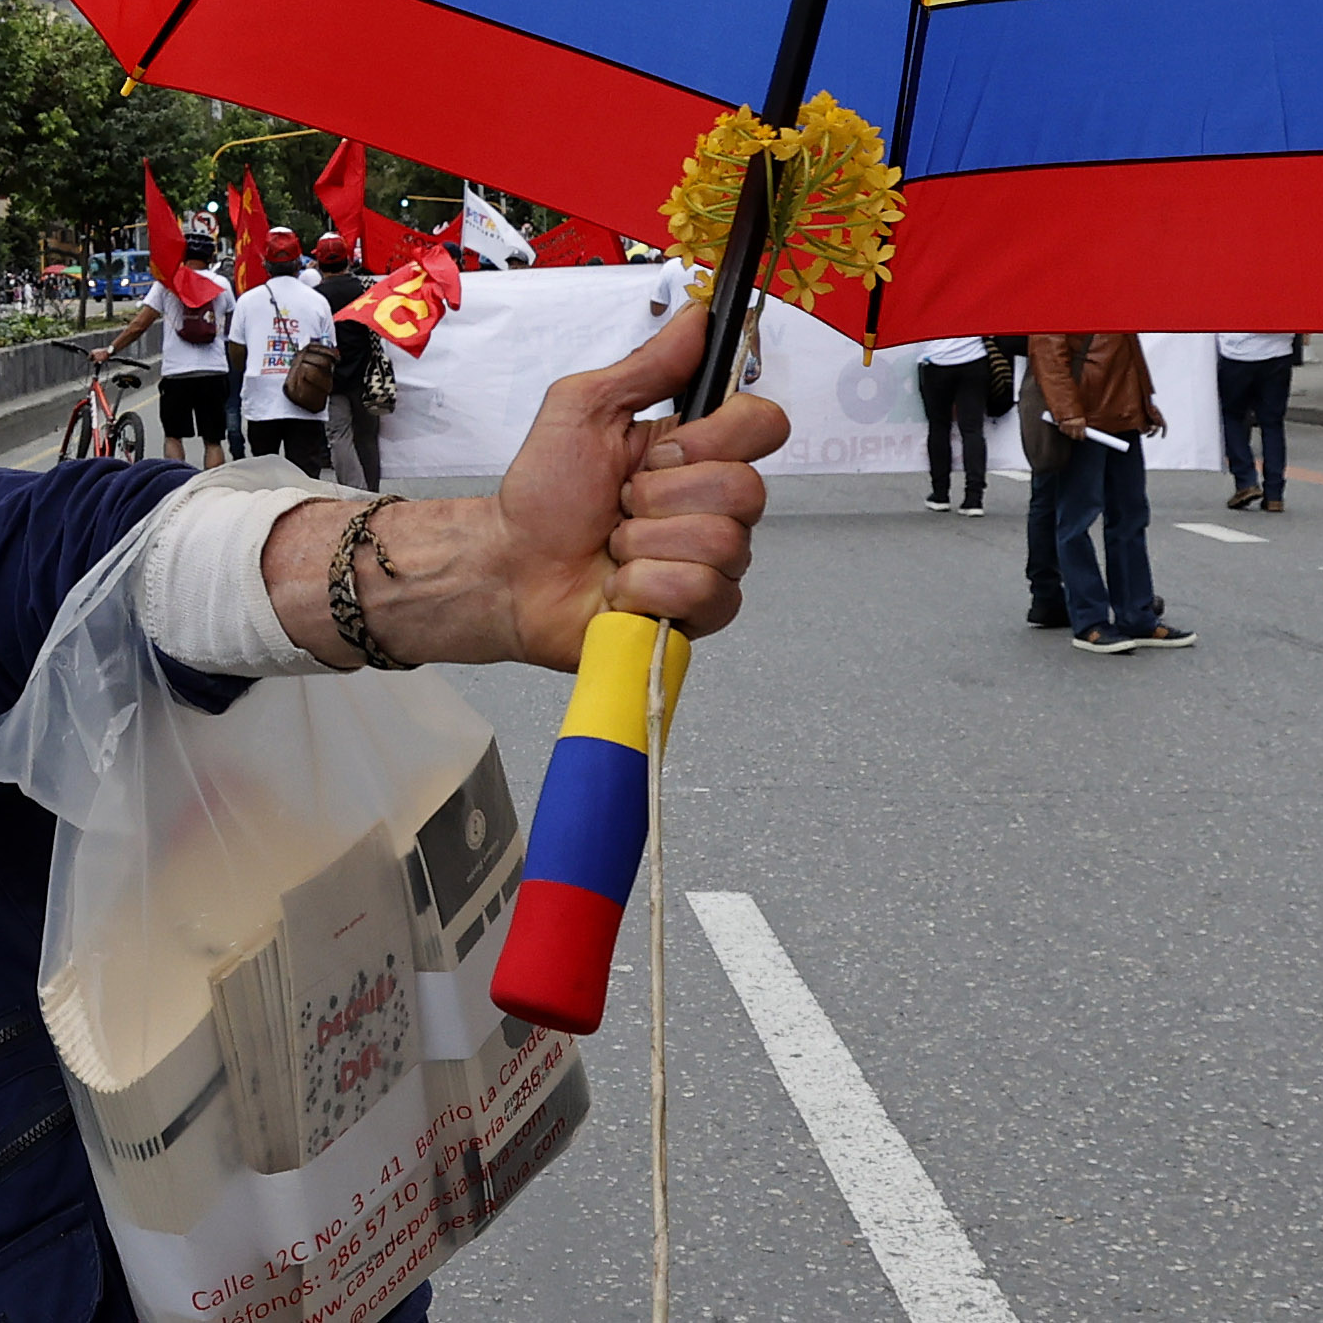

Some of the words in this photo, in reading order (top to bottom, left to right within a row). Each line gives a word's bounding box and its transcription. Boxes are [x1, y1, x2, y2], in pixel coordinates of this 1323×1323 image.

[191, 1274, 255, 1311] Calle
[264, 1240, 309, 1281] 12C
[315, 1218, 348, 1253] No.
[351, 1192, 365, 1216] 3
[380, 1156, 404, 1185] 41
[415, 1104, 472, 1159] Barrio
[479, 1086, 497, 1113] La
[499, 1026, 550, 1085] Cande
[223, 1274, 322, 1323] éfonos:
[327, 1232, 362, 1281] 286
[365, 1206, 386, 1241] 57
[392, 1182, 419, 1212] 10
[545, 1041, 563, 1070] 44
